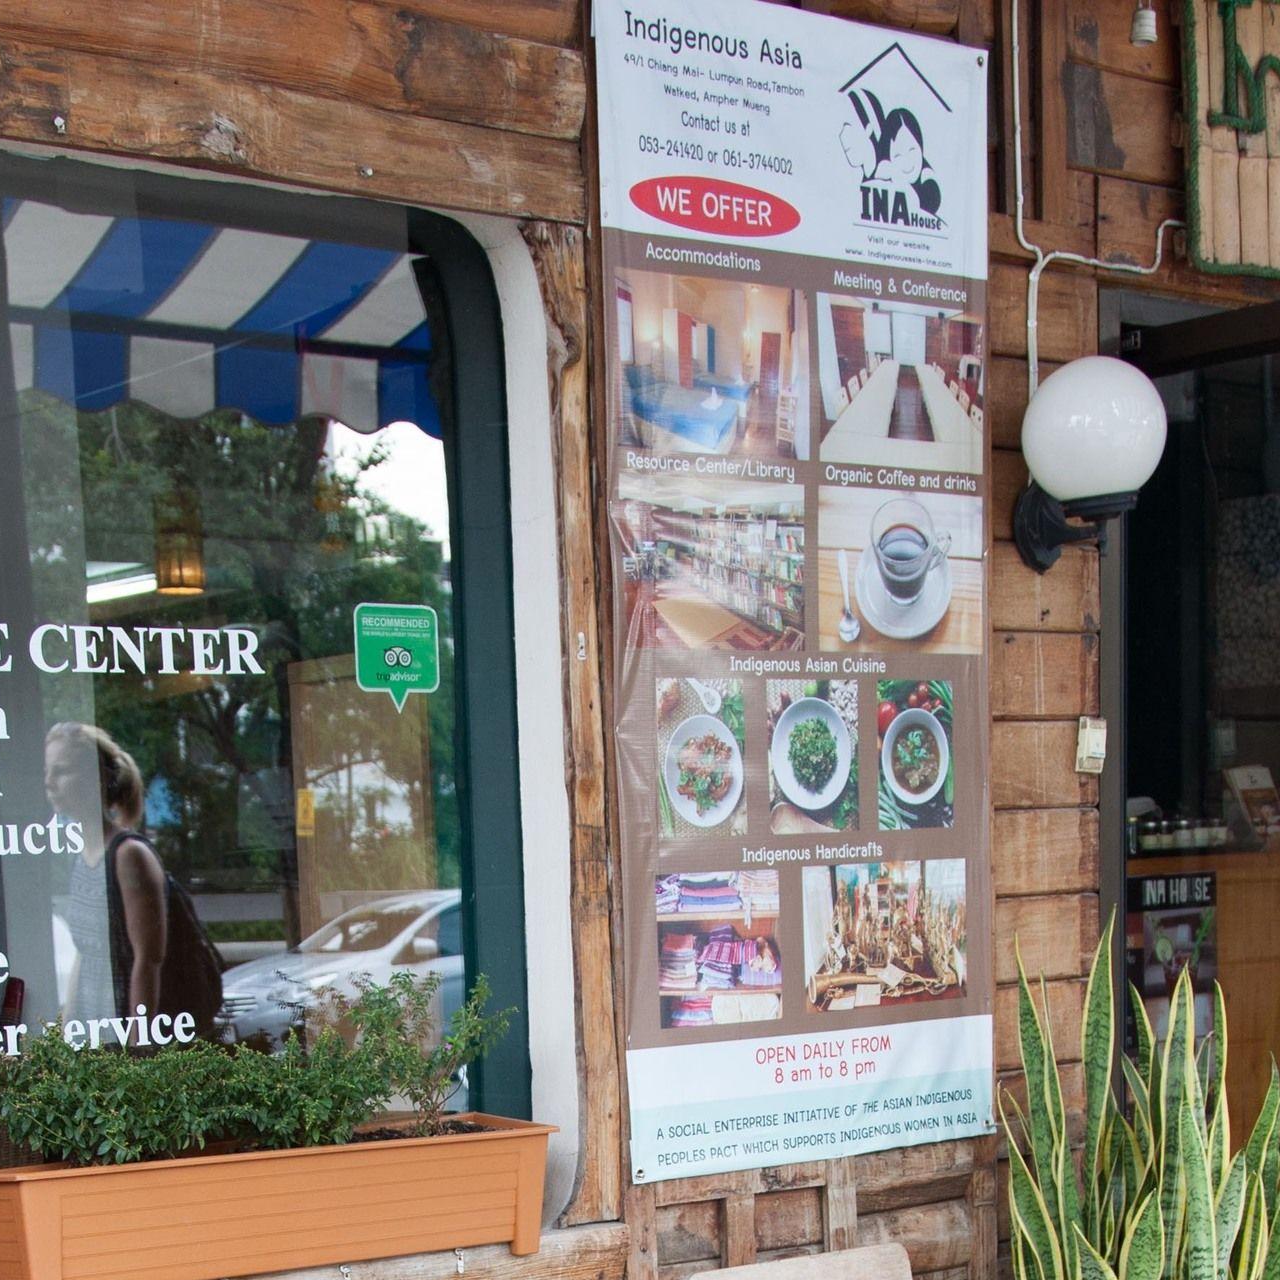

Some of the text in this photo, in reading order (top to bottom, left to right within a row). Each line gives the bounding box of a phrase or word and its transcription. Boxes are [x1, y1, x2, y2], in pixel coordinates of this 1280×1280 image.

[624, 10, 803, 69] Indigenous Asia
[623, 53, 645, 67] 49/1
[647, 58, 678, 77] Chiang
[681, 111, 750, 136] Contact us at
[638, 135, 793, 175] 053-241420 or 061-3744002
[656, 185, 772, 227] WE OFFER
[860, 185, 910, 226] INA
[911, 212, 942, 231] House
[645, 241, 761, 272] Accommodations
[867, 235, 930, 251] Visit our website
[833, 270, 967, 303] Meeting & Conference
[626, 452, 795, 484] Resource Center/Library
[825, 464, 977, 492] Organic Coffee and drinks
[362, 617, 430, 629] RECOMMENDED
[28, 623, 267, 676] CENTER
[729, 655, 887, 676] Indigenous Asian Cuisine
[742, 841, 883, 865] Indigenous Handicrafts
[42, 1003, 196, 1052] ervice
[755, 1035, 892, 1065] OPEN DAILY FROM
[775, 1060, 876, 1084] 8 am to 8 pm
[656, 1088, 973, 1140] A SOCIAL ENTERPRISE INITIATIVE OF THE ASIAN INDIGENOUS
[657, 1112, 978, 1167] PEOPLES PACT WHICH SUPPORTS INDIGENOUS WOMEN IN ASIA
